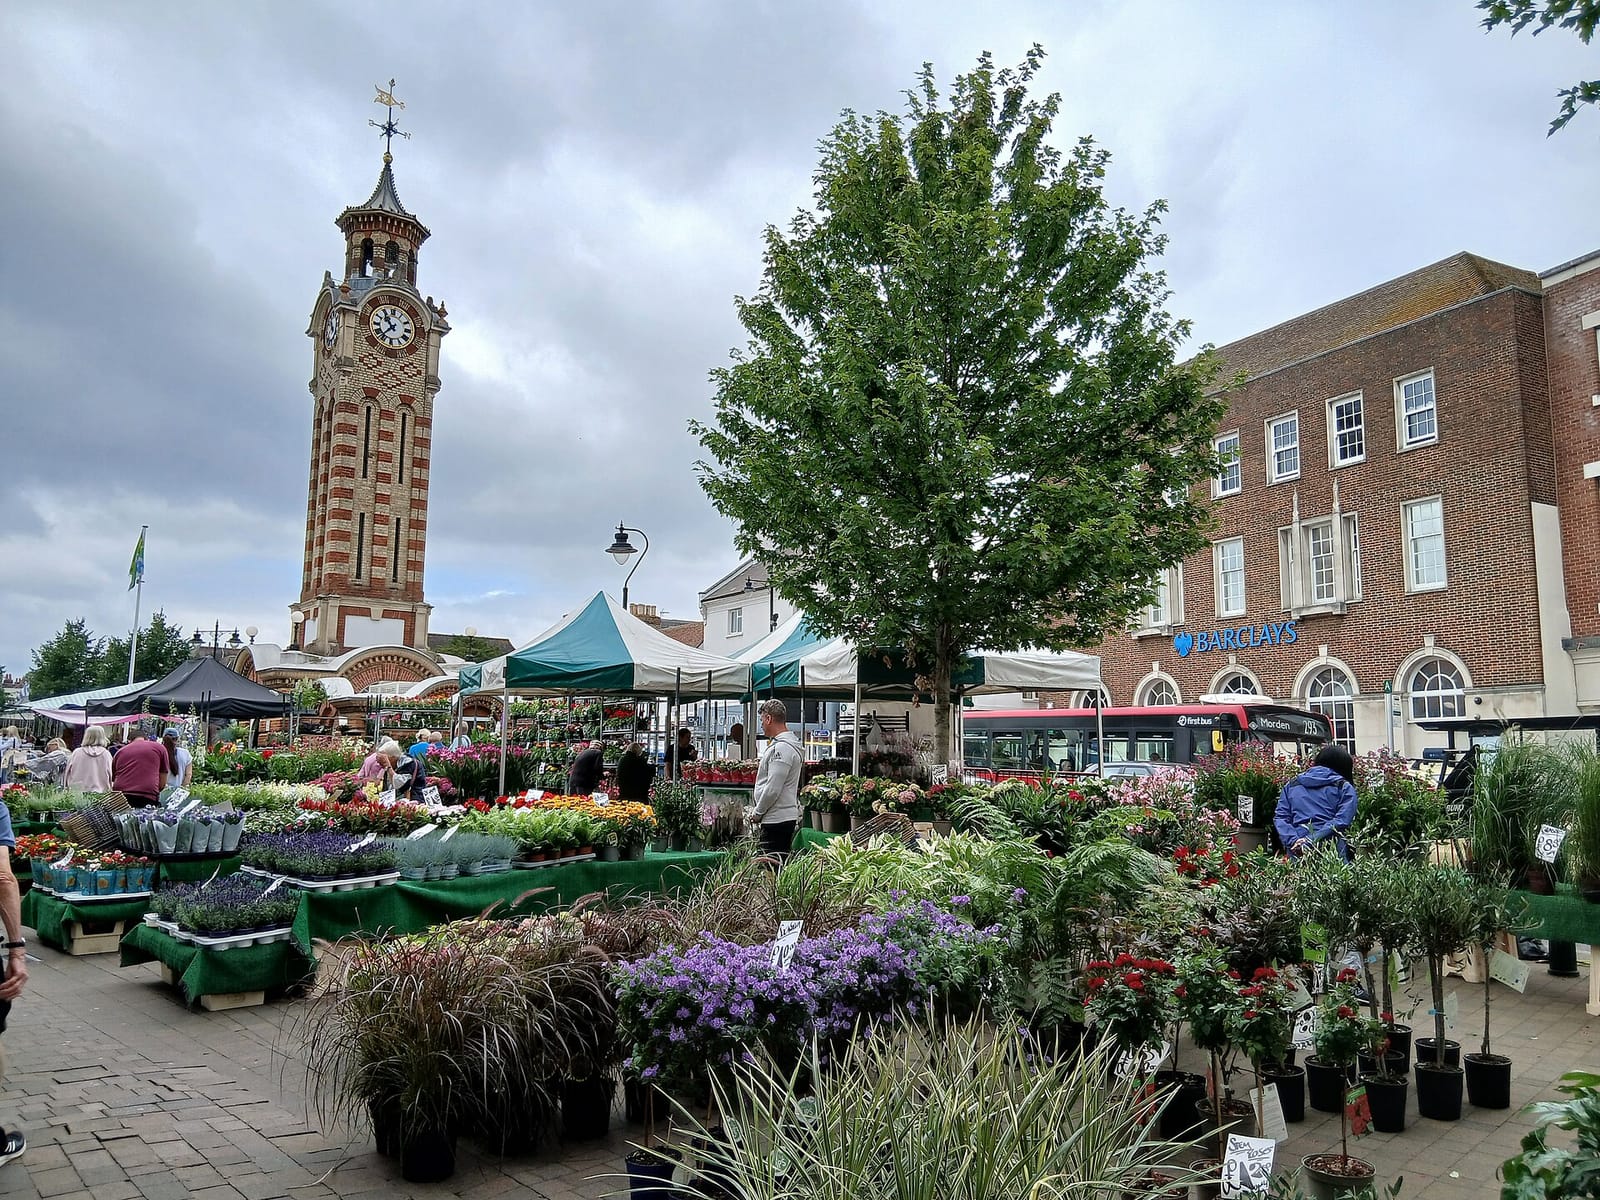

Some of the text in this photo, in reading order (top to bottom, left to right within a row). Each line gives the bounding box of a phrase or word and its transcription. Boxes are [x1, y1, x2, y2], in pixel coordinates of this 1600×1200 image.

[1196, 620, 1298, 653] BARCLAYS
[1384, 680, 1391, 690] A
[1260, 717, 1291, 731] Morden
[1302, 720, 1318, 735] 293
